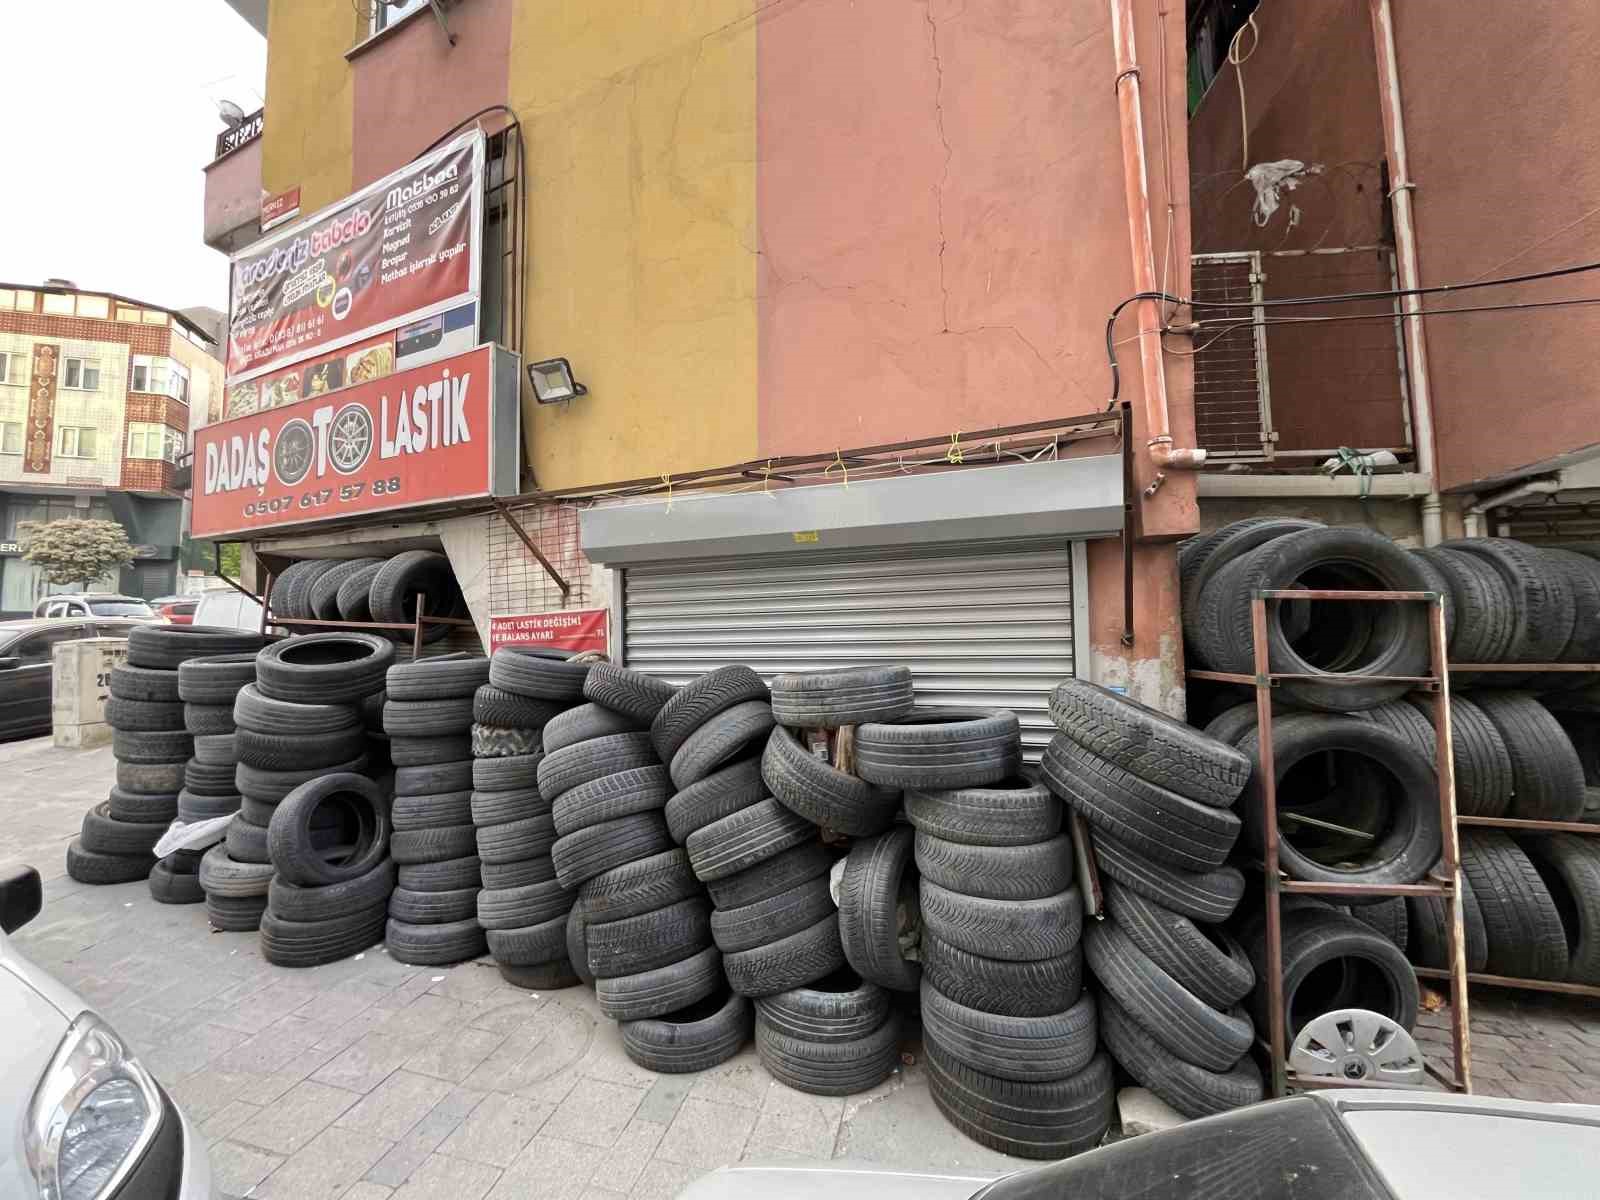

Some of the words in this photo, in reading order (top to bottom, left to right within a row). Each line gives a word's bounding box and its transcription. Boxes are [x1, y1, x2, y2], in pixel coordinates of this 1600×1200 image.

[204, 427, 271, 497] DADAŞ
[379, 368, 472, 460] LASTİK
[243, 496, 294, 518] 0507
[298, 488, 332, 510] 617
[339, 482, 366, 503] 57
[372, 476, 401, 497] 88
